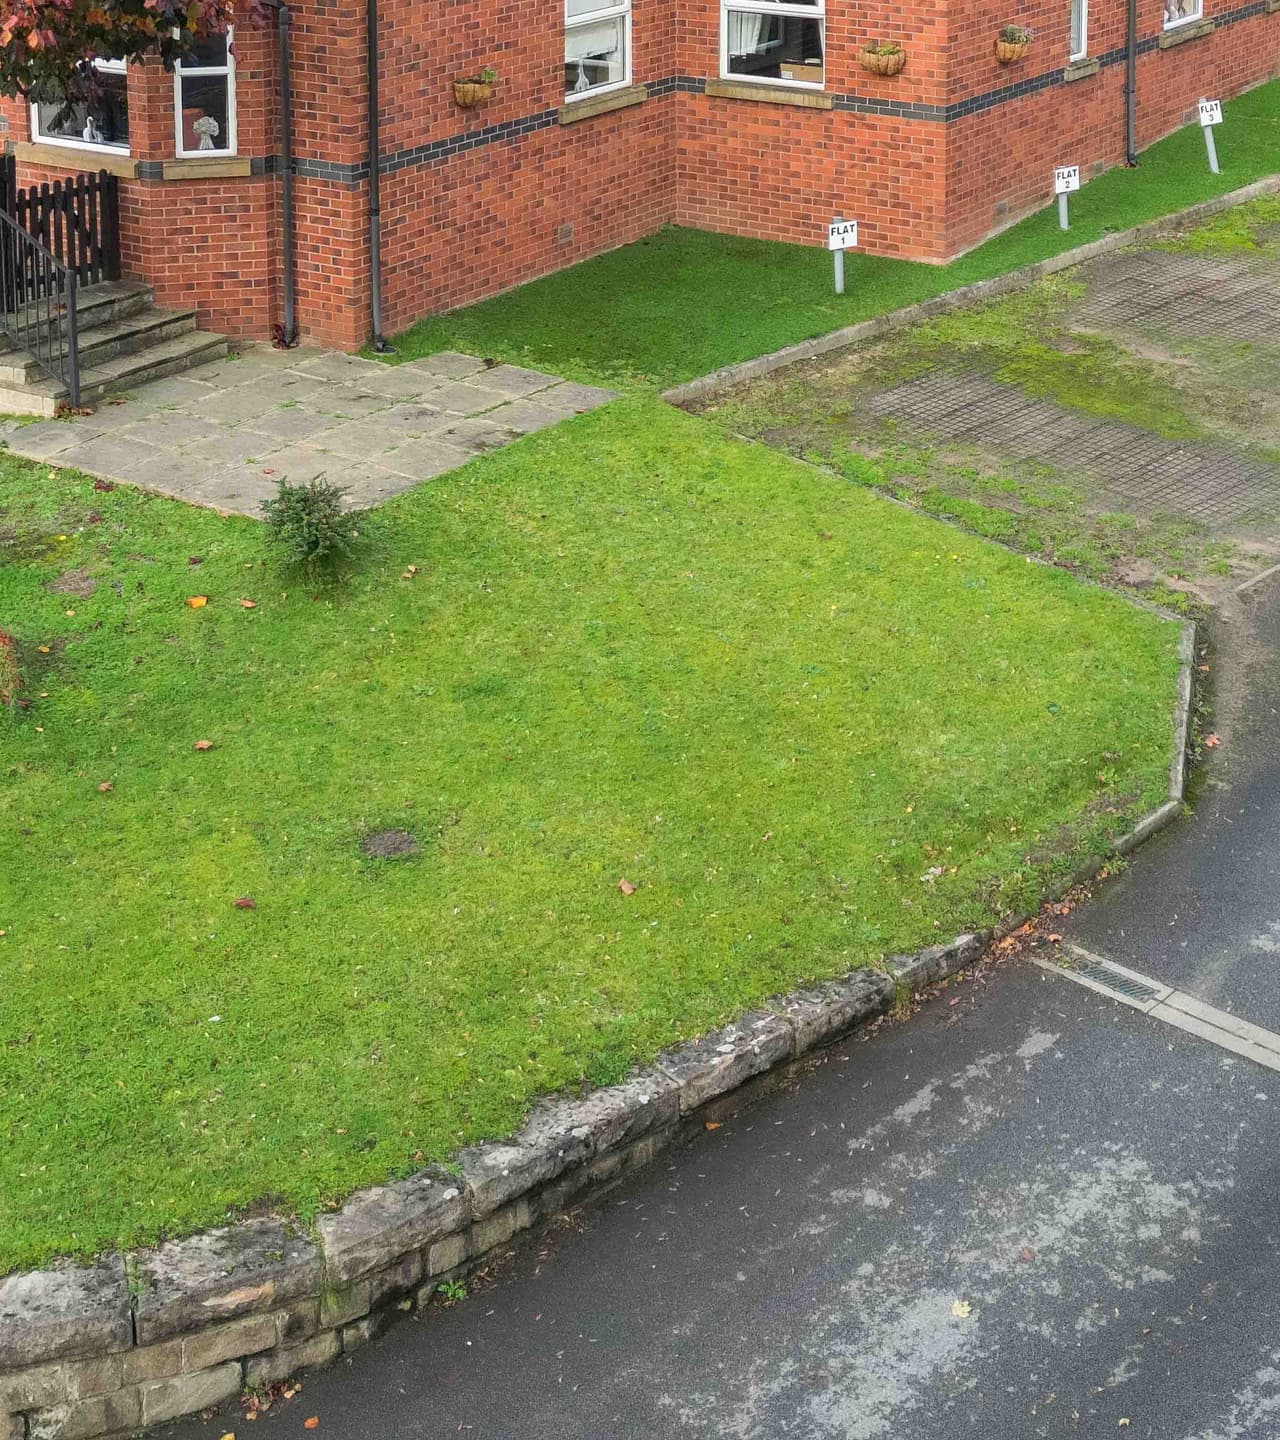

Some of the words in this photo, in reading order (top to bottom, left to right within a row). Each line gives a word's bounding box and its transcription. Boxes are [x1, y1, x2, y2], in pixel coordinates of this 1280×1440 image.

[1201, 103, 1218, 114] FLAT
[1209, 113, 1215, 122] 3
[1057, 169, 1077, 181] FLAT
[1065, 180, 1071, 189] 2
[831, 223, 855, 236] FLAT
[841, 236, 845, 245] 1
